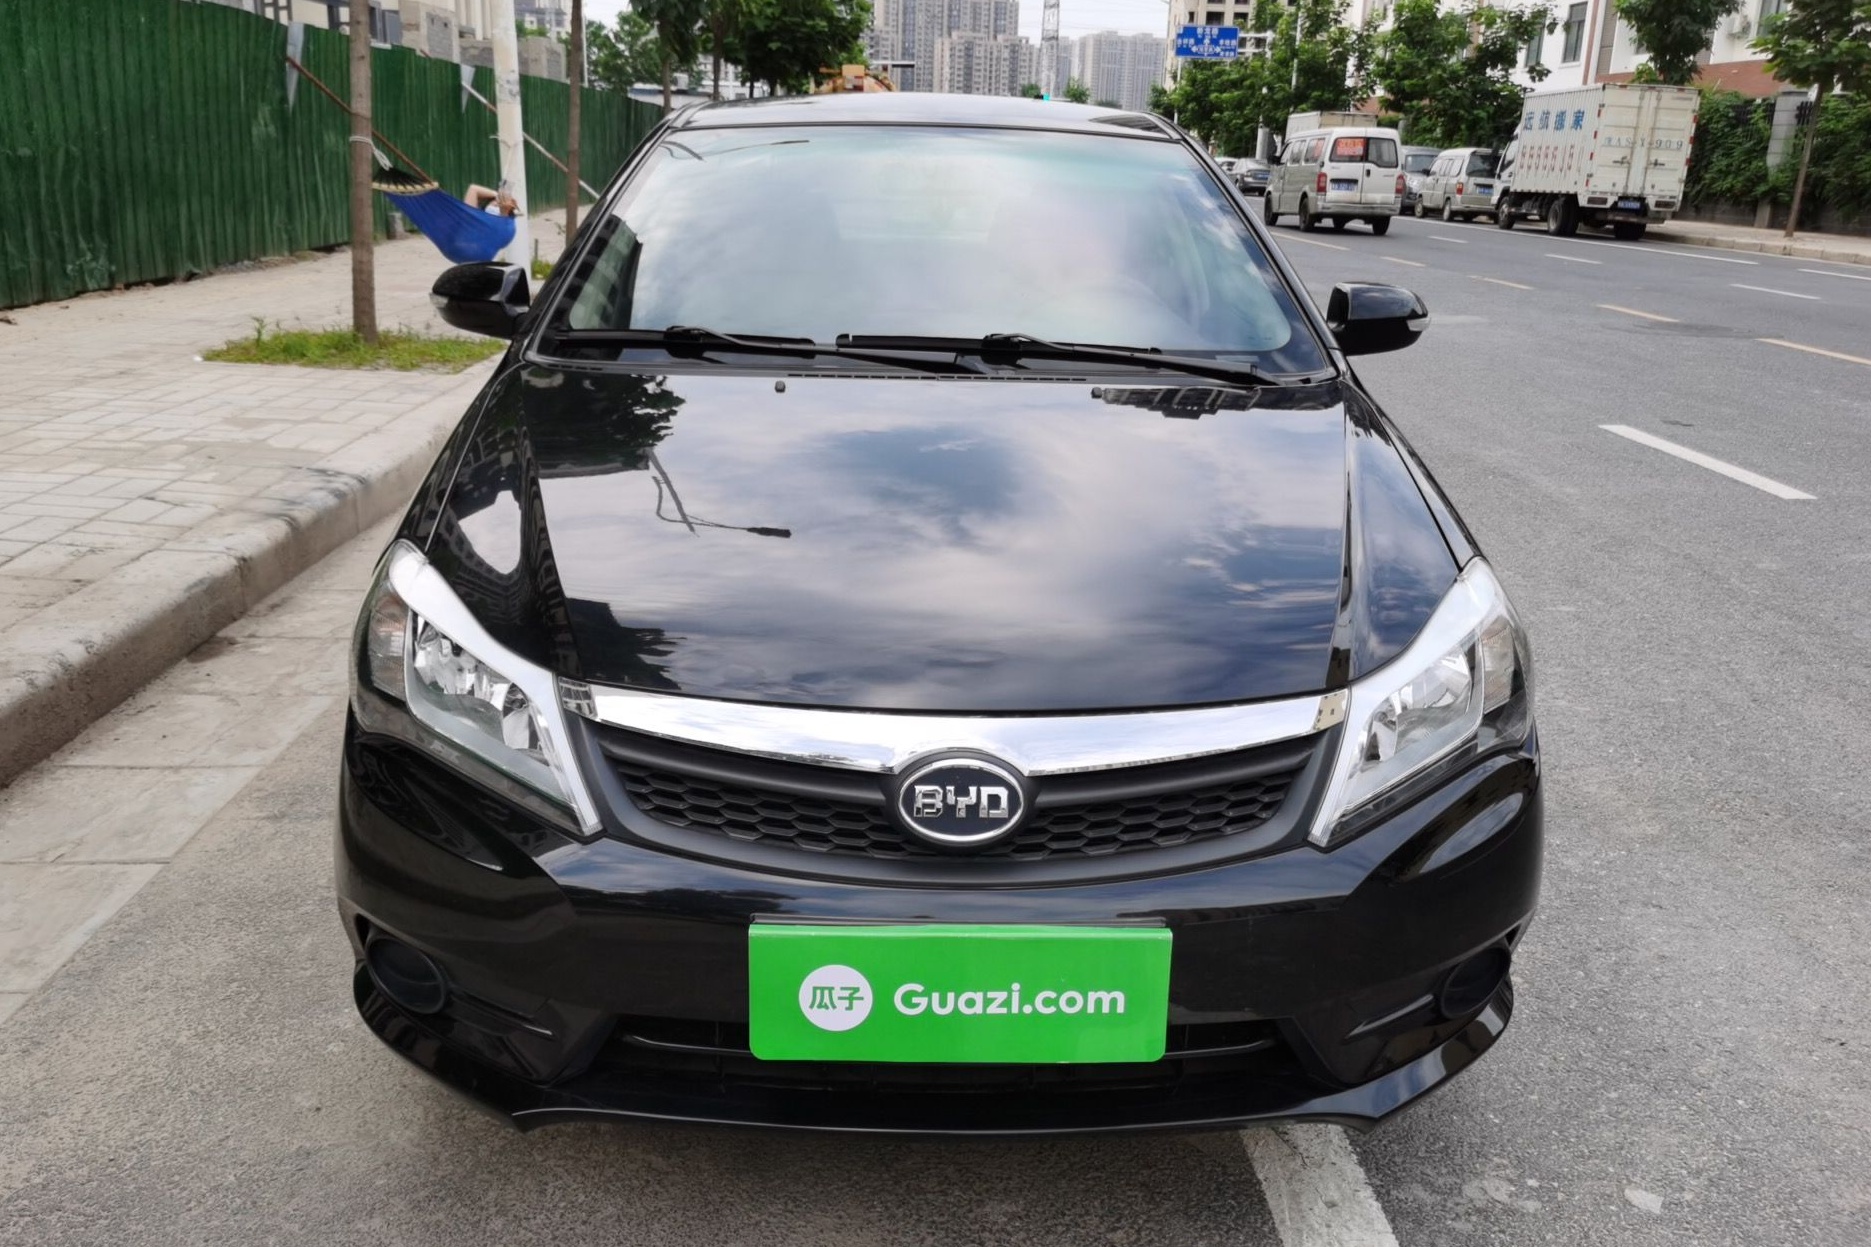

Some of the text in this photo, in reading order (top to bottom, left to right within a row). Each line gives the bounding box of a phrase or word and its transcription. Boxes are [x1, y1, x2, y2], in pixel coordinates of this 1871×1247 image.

[913, 785, 1008, 818] BYD
[808, 982, 1126, 1016] 瓜子 Guazi.com
